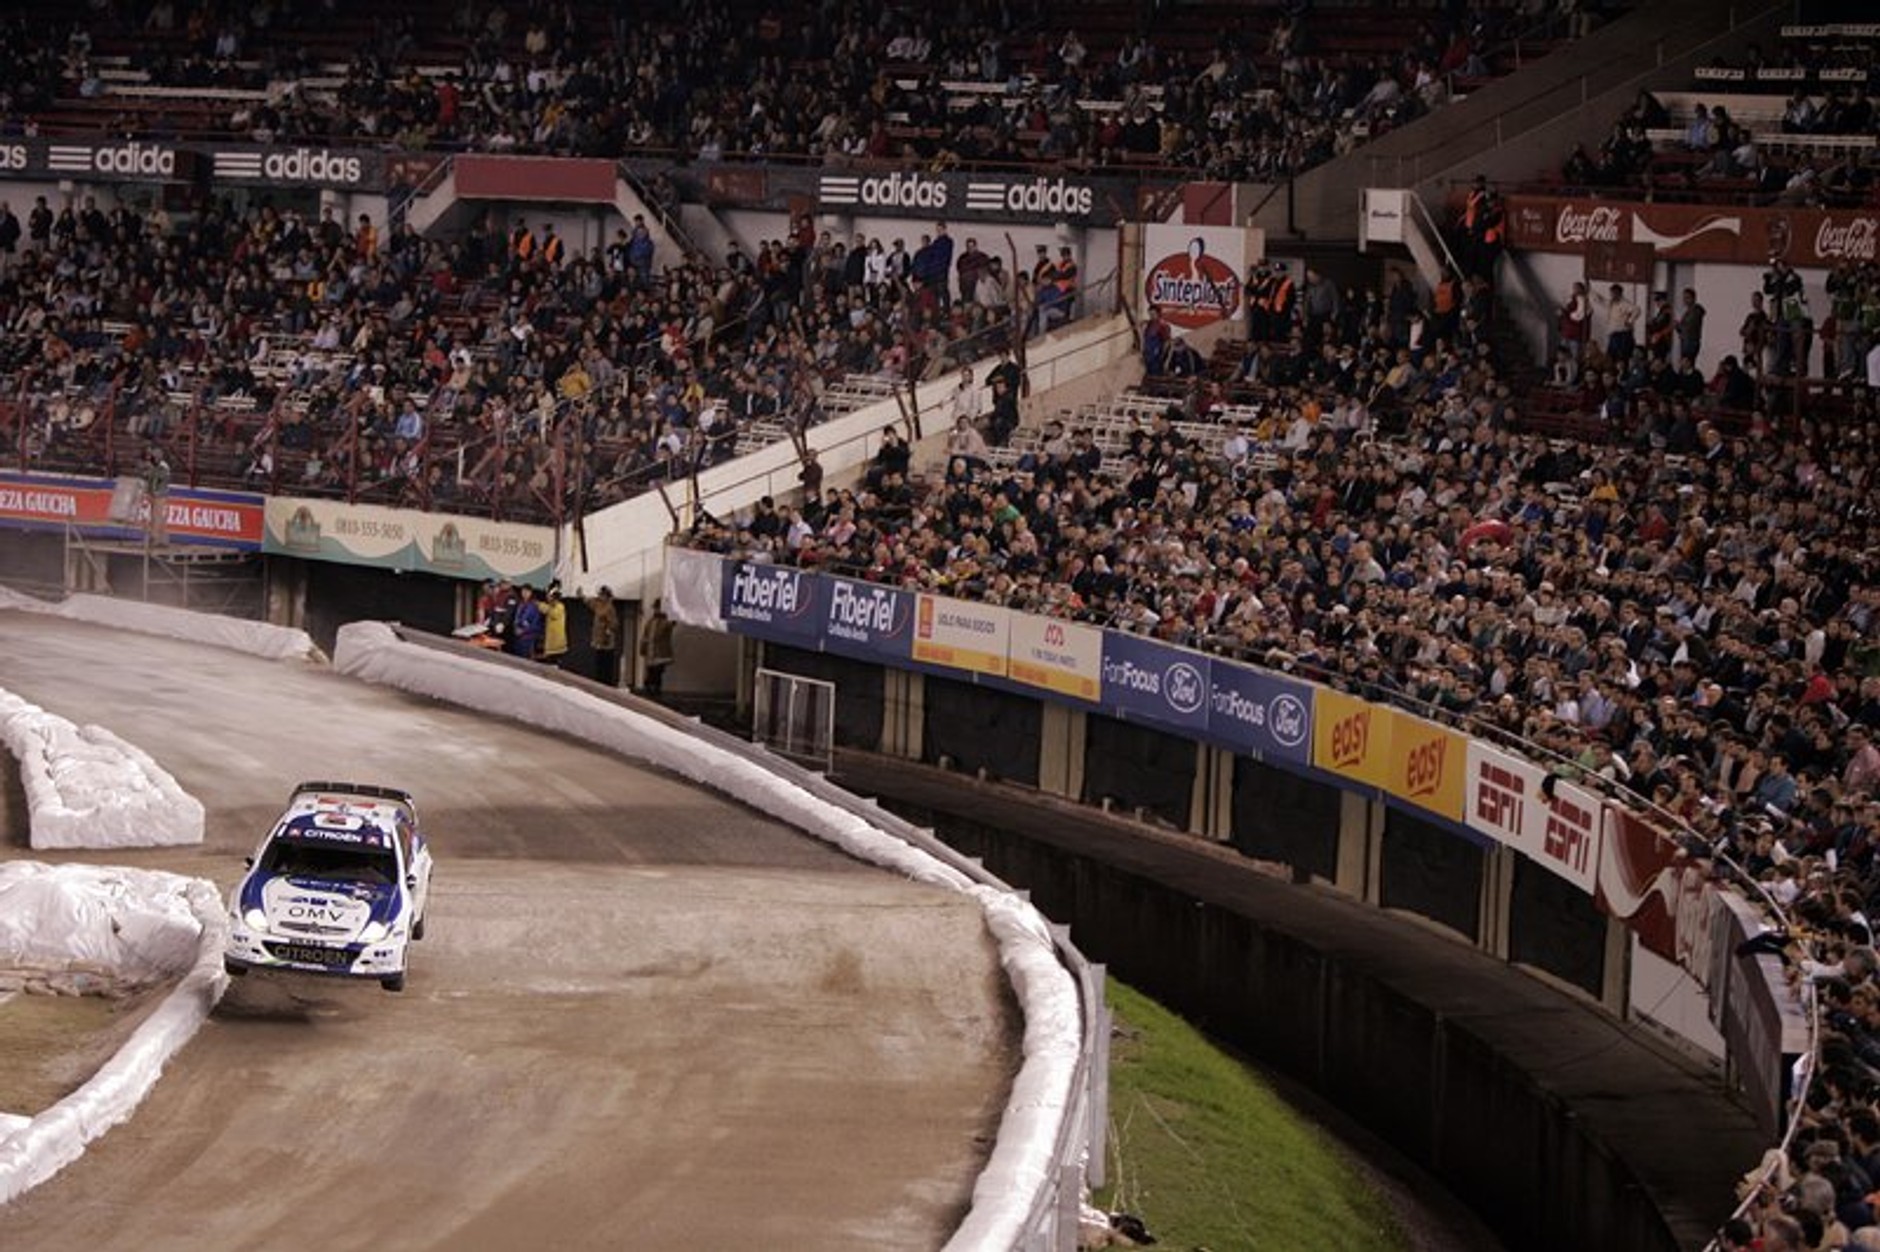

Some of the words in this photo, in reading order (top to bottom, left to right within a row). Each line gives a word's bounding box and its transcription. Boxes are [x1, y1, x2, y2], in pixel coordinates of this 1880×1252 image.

[0, 145, 27, 169] as
[96, 142, 175, 174] adida
[265, 148, 361, 182] adidas
[862, 172, 947, 208] adidas
[1008, 177, 1092, 214] adidas
[732, 564, 800, 612] FiberTel
[829, 580, 897, 632] FiberTel
[1332, 708, 1371, 768] easy
[1406, 735, 1446, 796] easy
[1477, 760, 1524, 836] ESPN
[1544, 795, 1592, 875] ESPN
[289, 906, 344, 922] OMV
